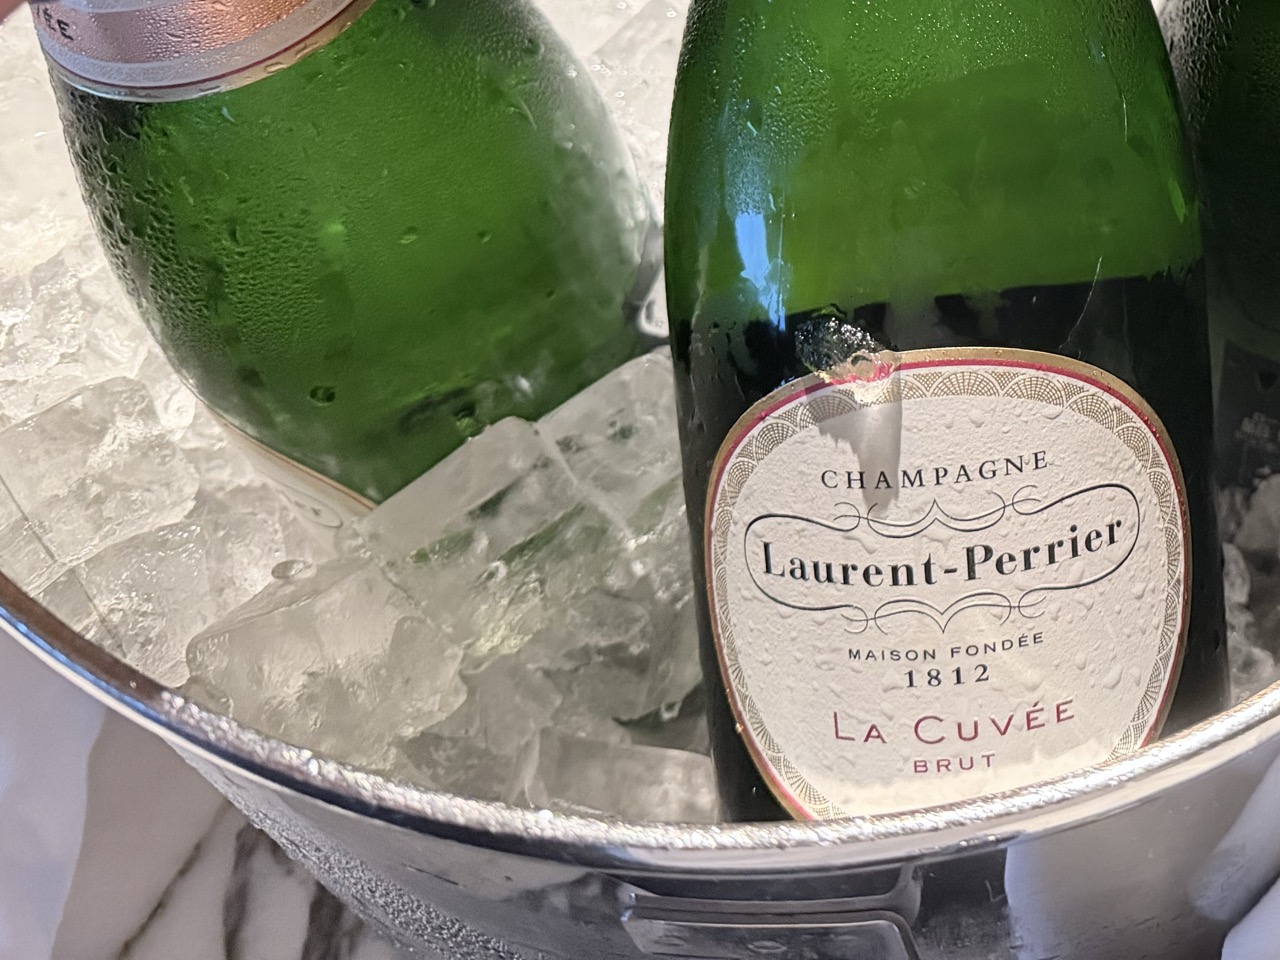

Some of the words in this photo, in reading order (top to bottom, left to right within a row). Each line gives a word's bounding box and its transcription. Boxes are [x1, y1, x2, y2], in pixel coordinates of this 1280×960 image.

[820, 450, 1049, 491] CHAMPAGNE
[761, 517, 1124, 588] Laurent-Perrier
[848, 647, 937, 662] MAISON
[949, 631, 1045, 659] FONDÉE
[904, 663, 992, 689] 1812
[832, 710, 888, 744] LA
[912, 698, 1077, 745] CUVÉE
[913, 753, 996, 774] BRUT
